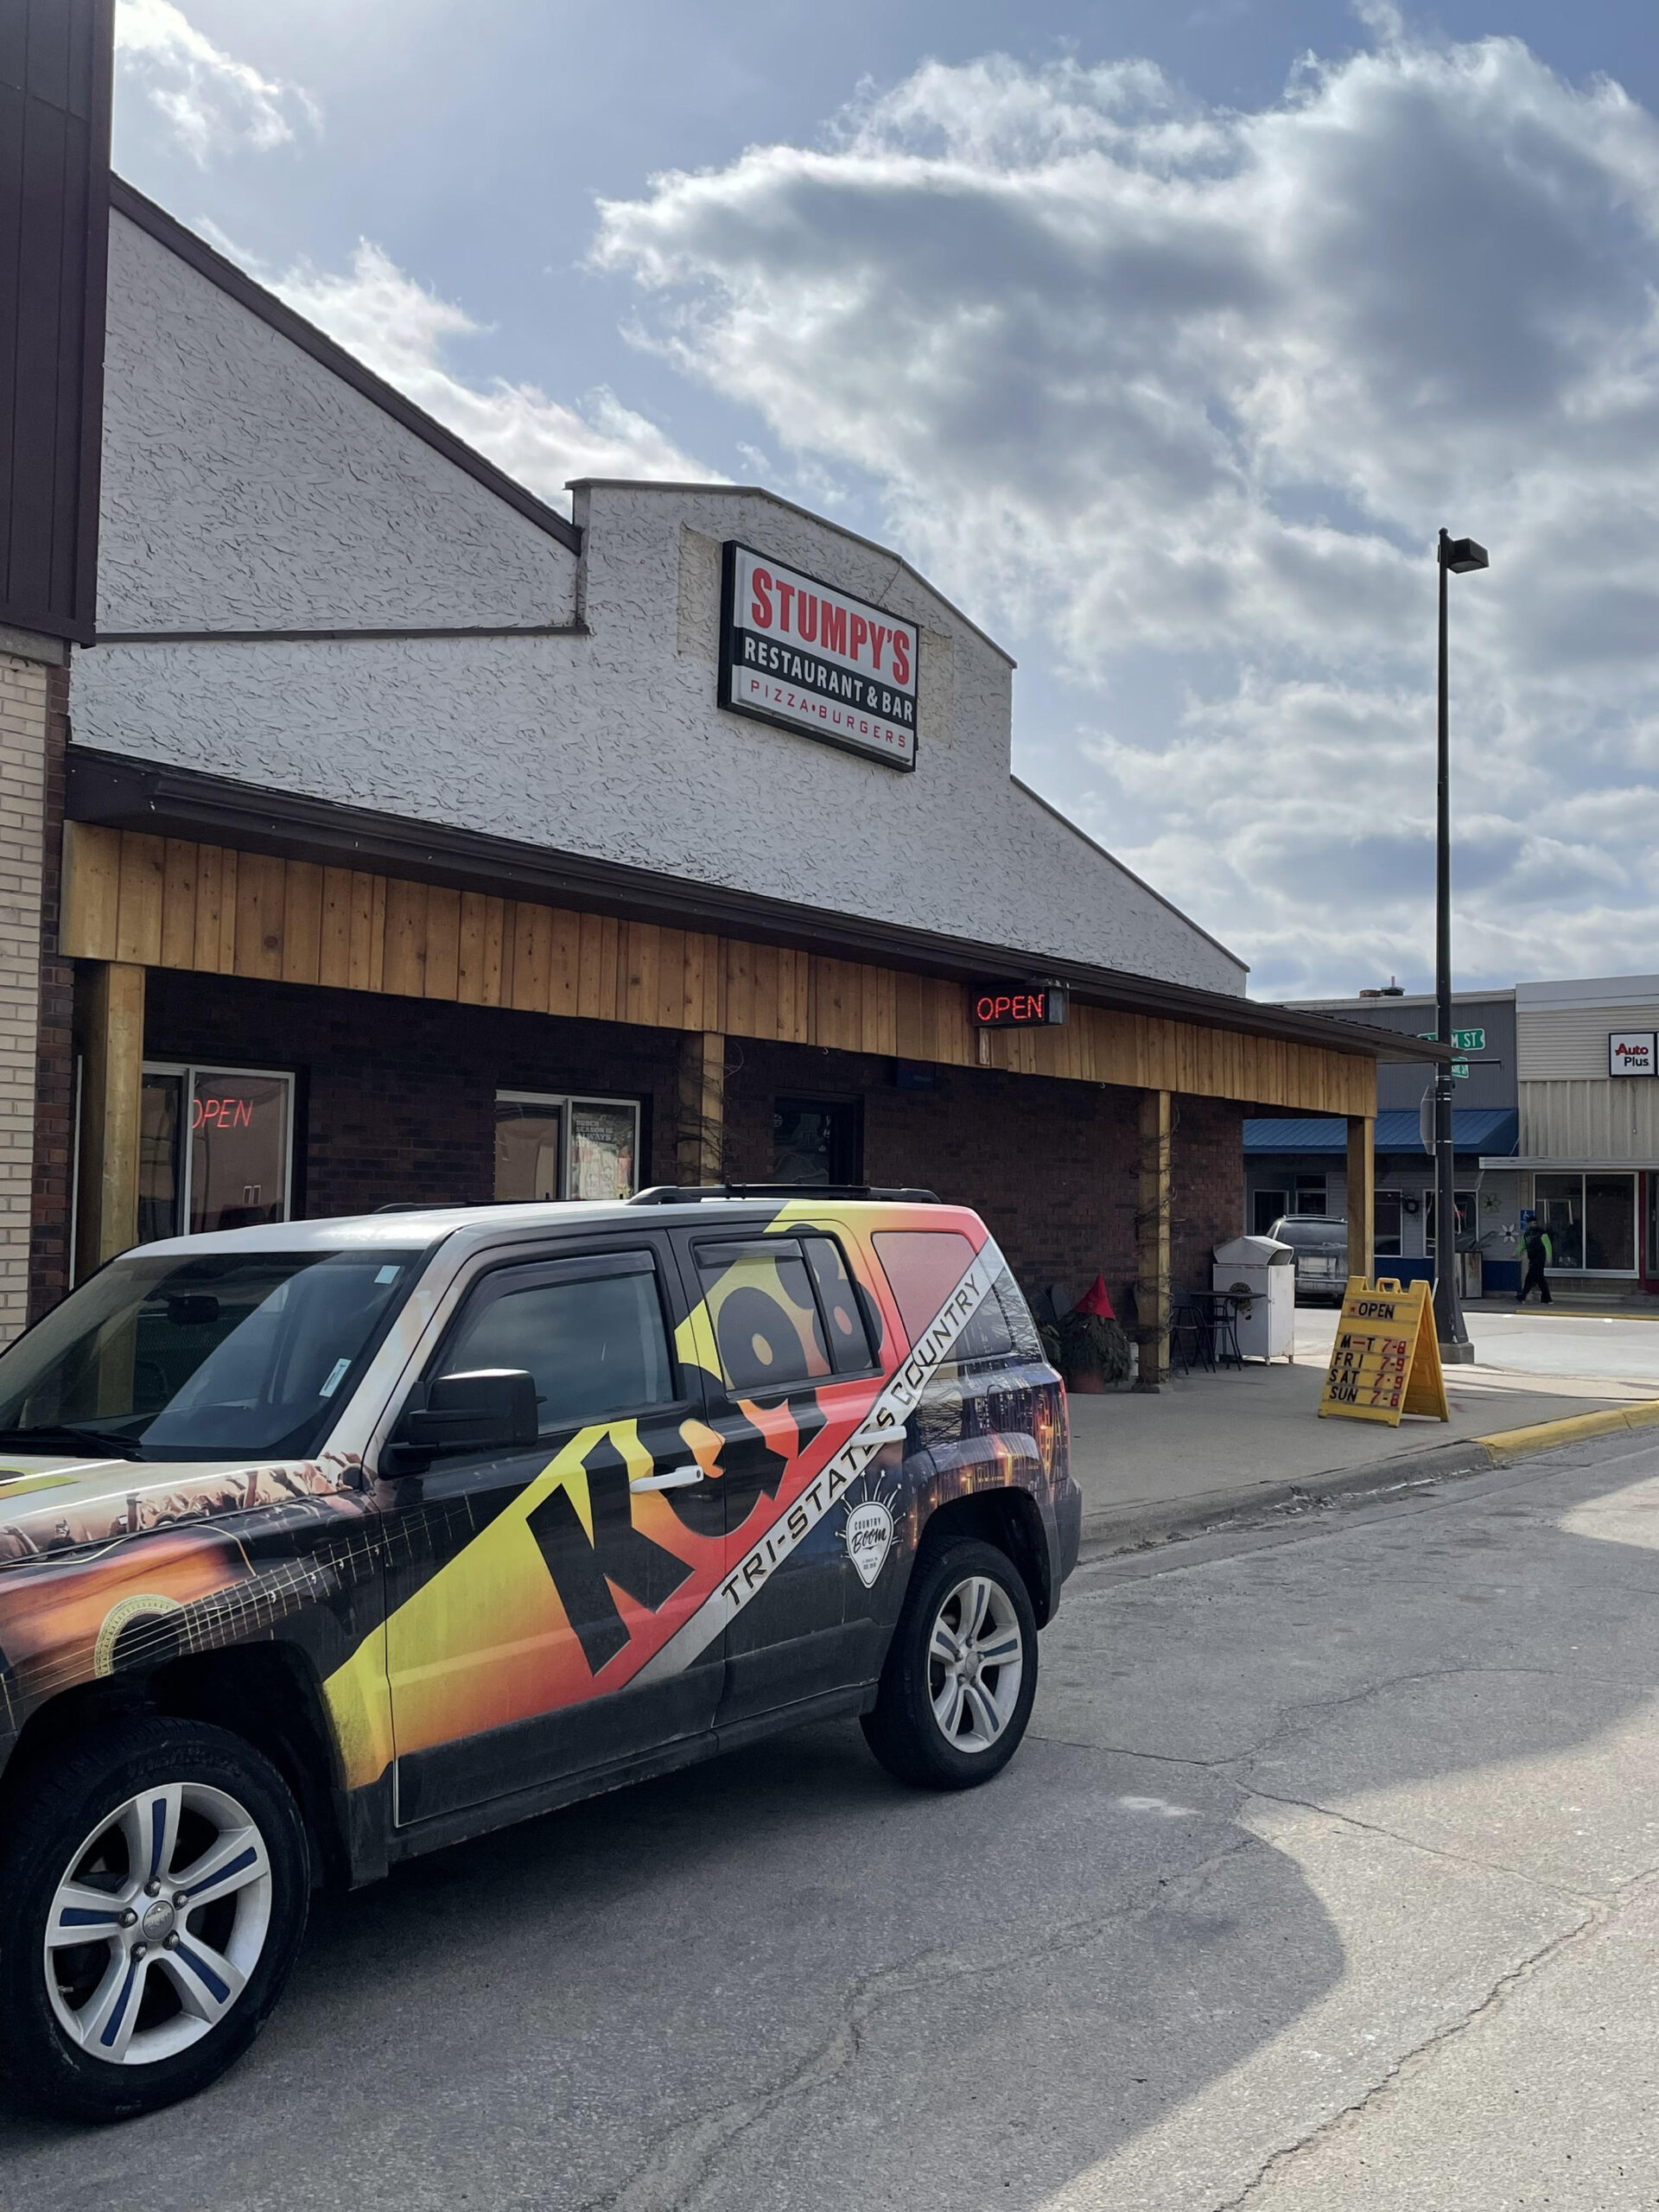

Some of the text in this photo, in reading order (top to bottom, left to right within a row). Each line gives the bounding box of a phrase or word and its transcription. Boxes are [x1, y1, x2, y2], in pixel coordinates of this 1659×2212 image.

[751, 567, 910, 685] STUMPY'S
[744, 636, 913, 722] RESTAURANT & BAR
[818, 705, 906, 747] BURGERS
[976, 993, 1046, 1020] OPEN
[1464, 1032, 1477, 1047] ST
[1615, 1043, 1649, 1056] Auto
[1624, 1056, 1649, 1067] Plus
[1358, 1302, 1395, 1319] OPEN
[890, 1274, 980, 1406] COUNTRY
[1334, 1352, 1405, 1372] FRI 7-9
[1329, 1369, 1360, 1384] SAT
[1329, 1386, 1358, 1402] SUN
[854, 1516, 882, 1531] COUNTRY
